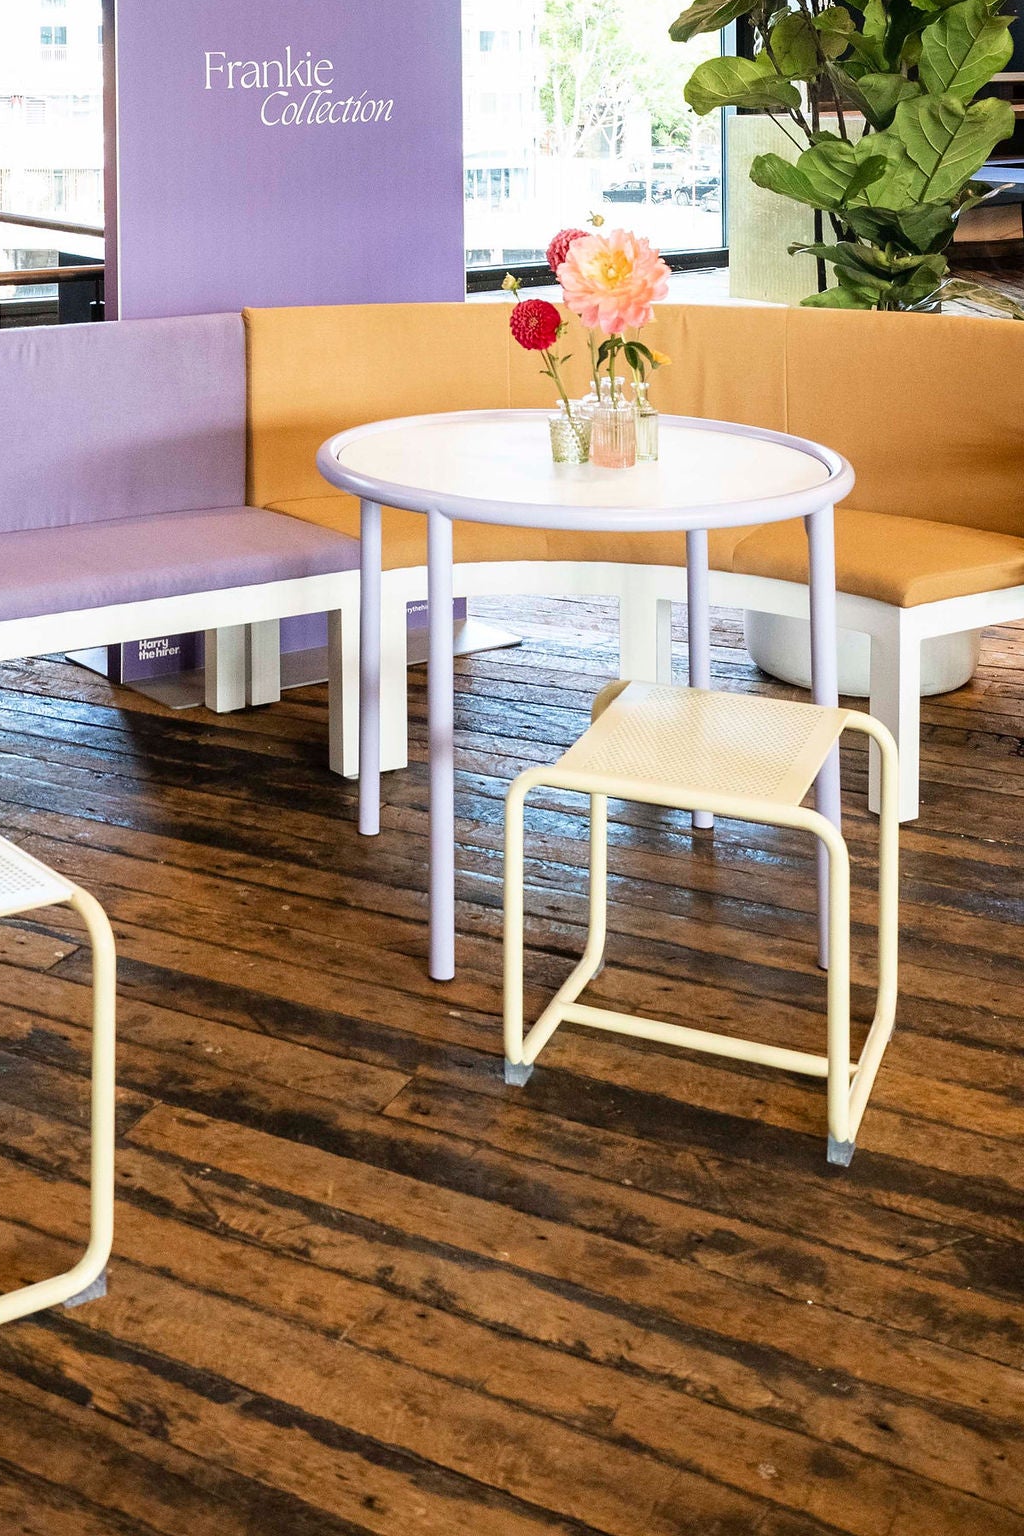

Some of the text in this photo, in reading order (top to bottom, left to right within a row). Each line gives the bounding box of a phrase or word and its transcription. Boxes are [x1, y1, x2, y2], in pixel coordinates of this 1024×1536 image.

[204, 45, 335, 90] Frankie
[260, 89, 394, 126] Collection
[138, 638, 169, 651] Harry
[138, 649, 155, 661] the
